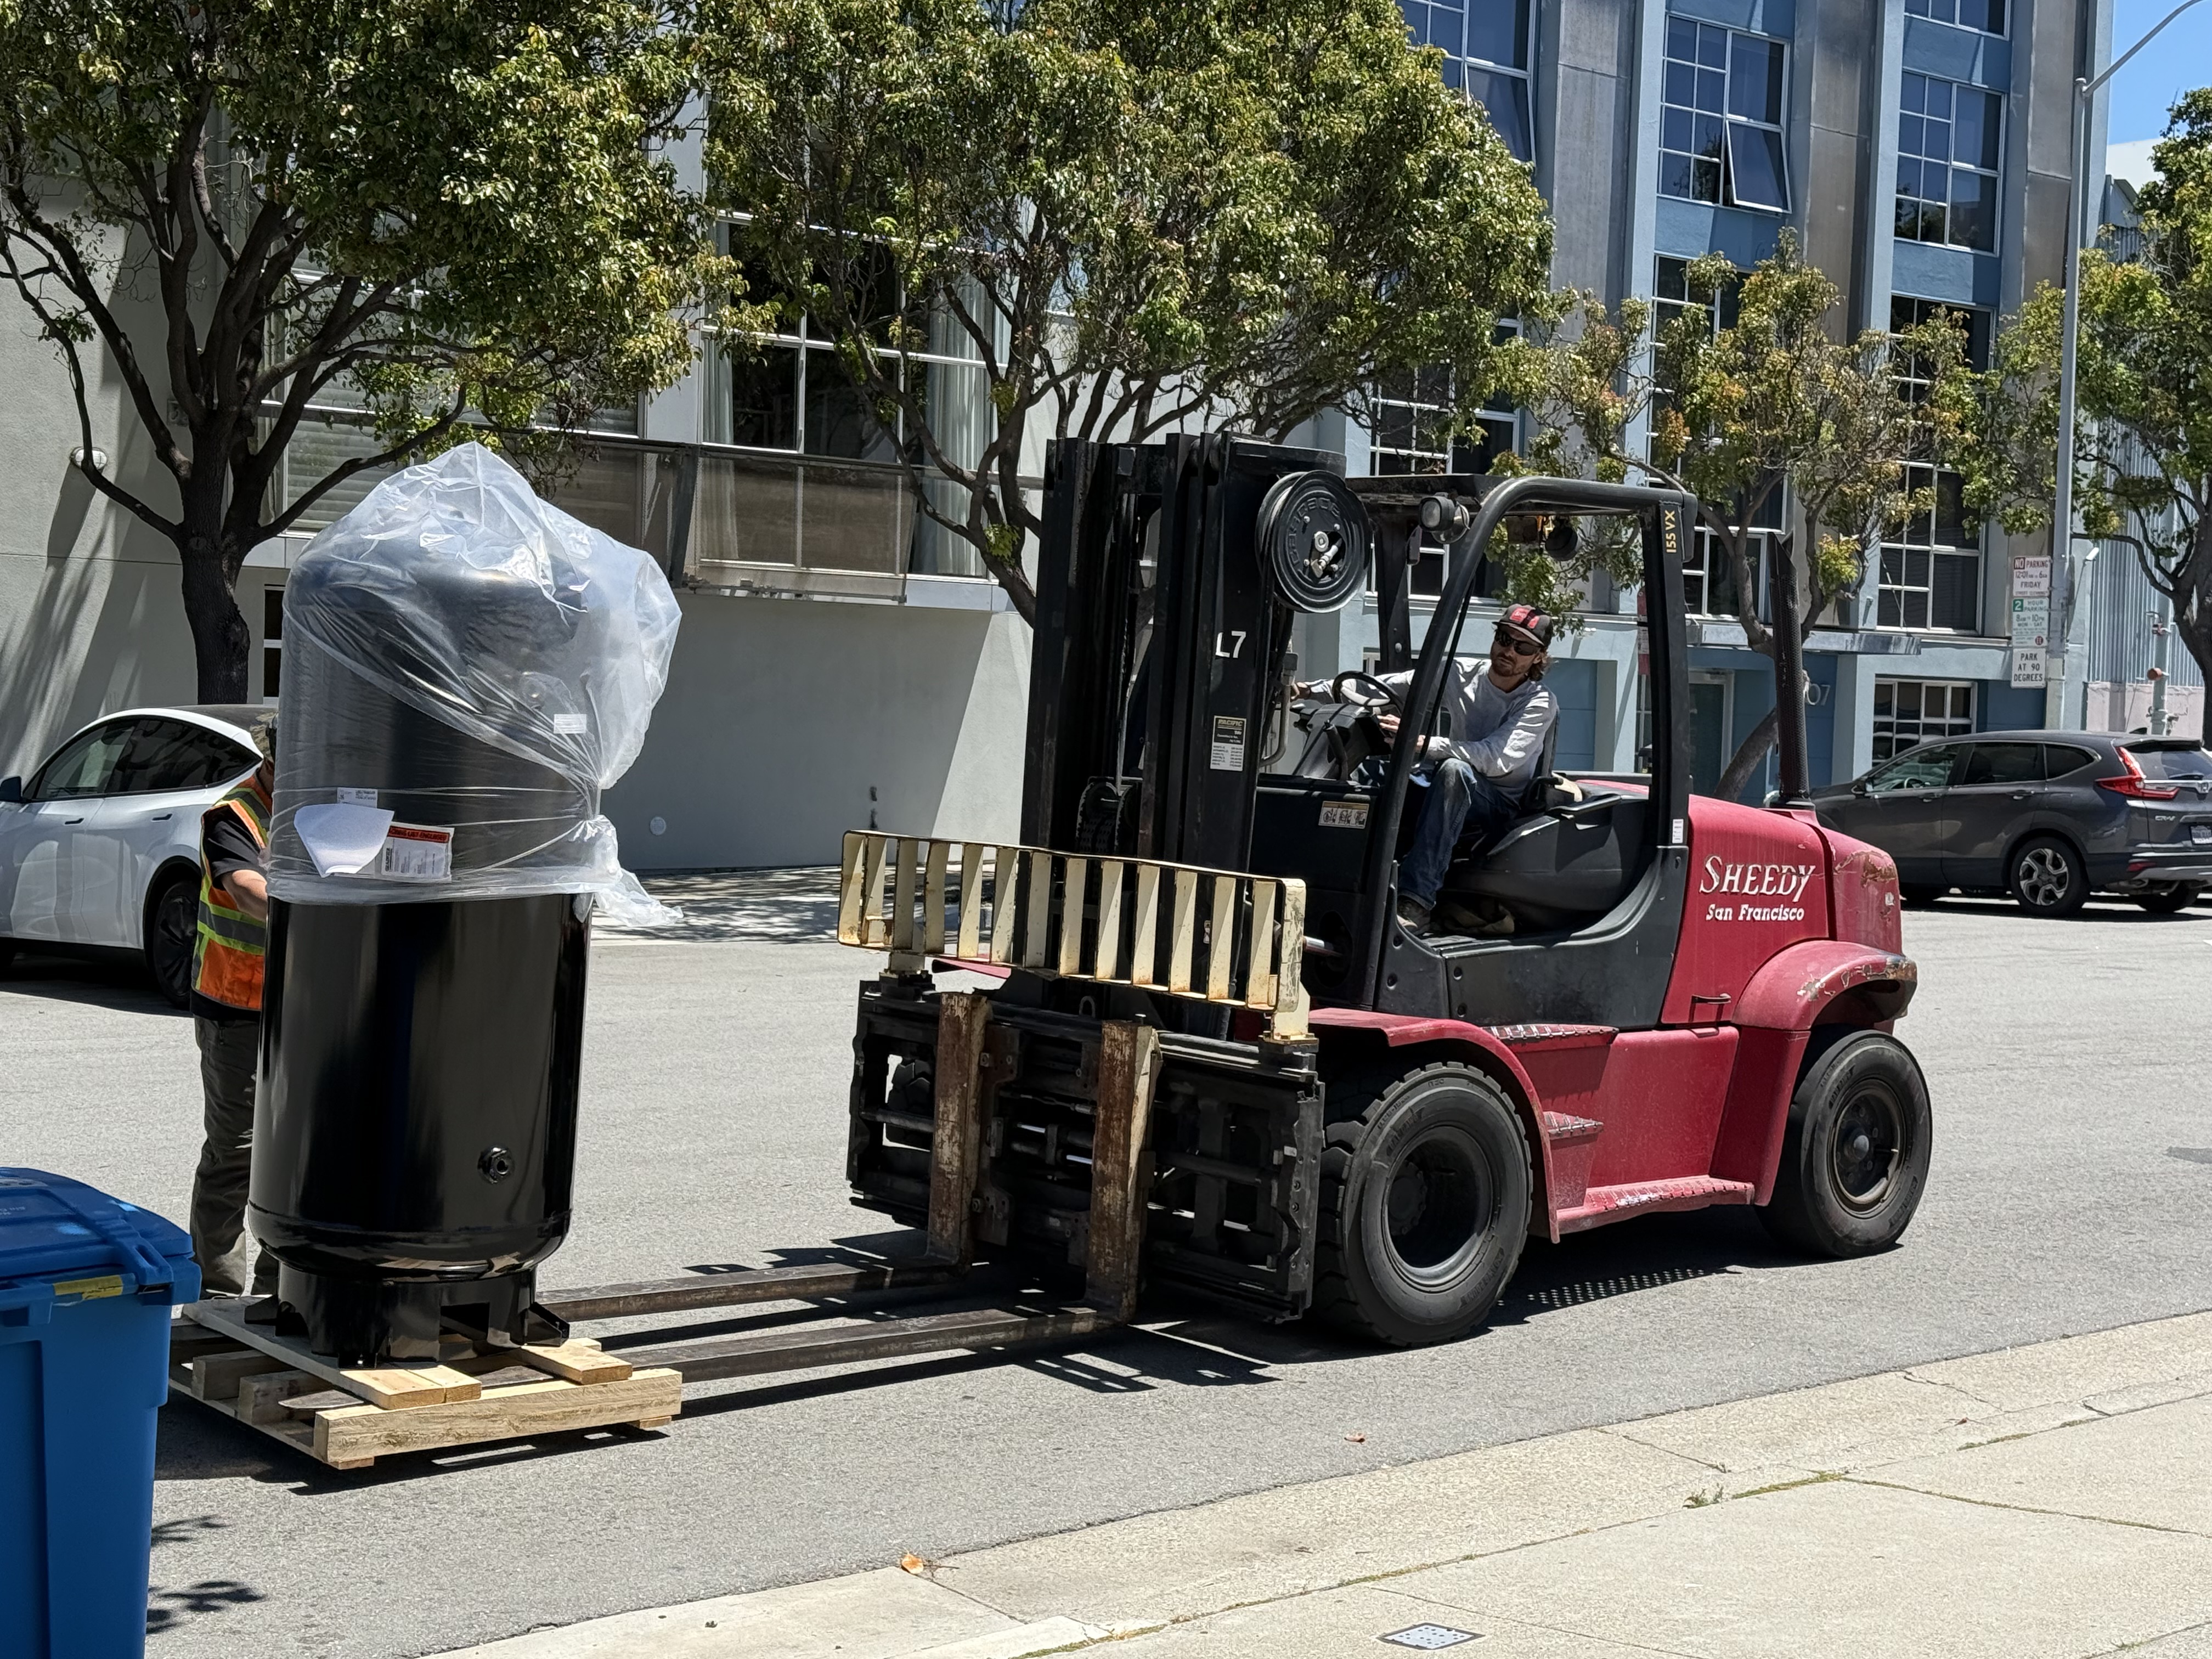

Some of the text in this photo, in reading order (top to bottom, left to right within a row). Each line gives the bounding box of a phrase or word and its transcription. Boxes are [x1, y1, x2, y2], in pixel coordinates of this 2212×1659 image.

[2015, 558, 2024, 568] NO
[2015, 600, 2022, 611] 2
[1215, 630, 1246, 658] L7
[2020, 653, 2038, 661] PARK
[2031, 663, 2040, 671] 90
[2013, 674, 2043, 682] DEGREES
[1218, 719, 1244, 727] PACIFIC
[1699, 855, 1816, 902] SHEEDY
[1706, 904, 1805, 921] San Francisco
